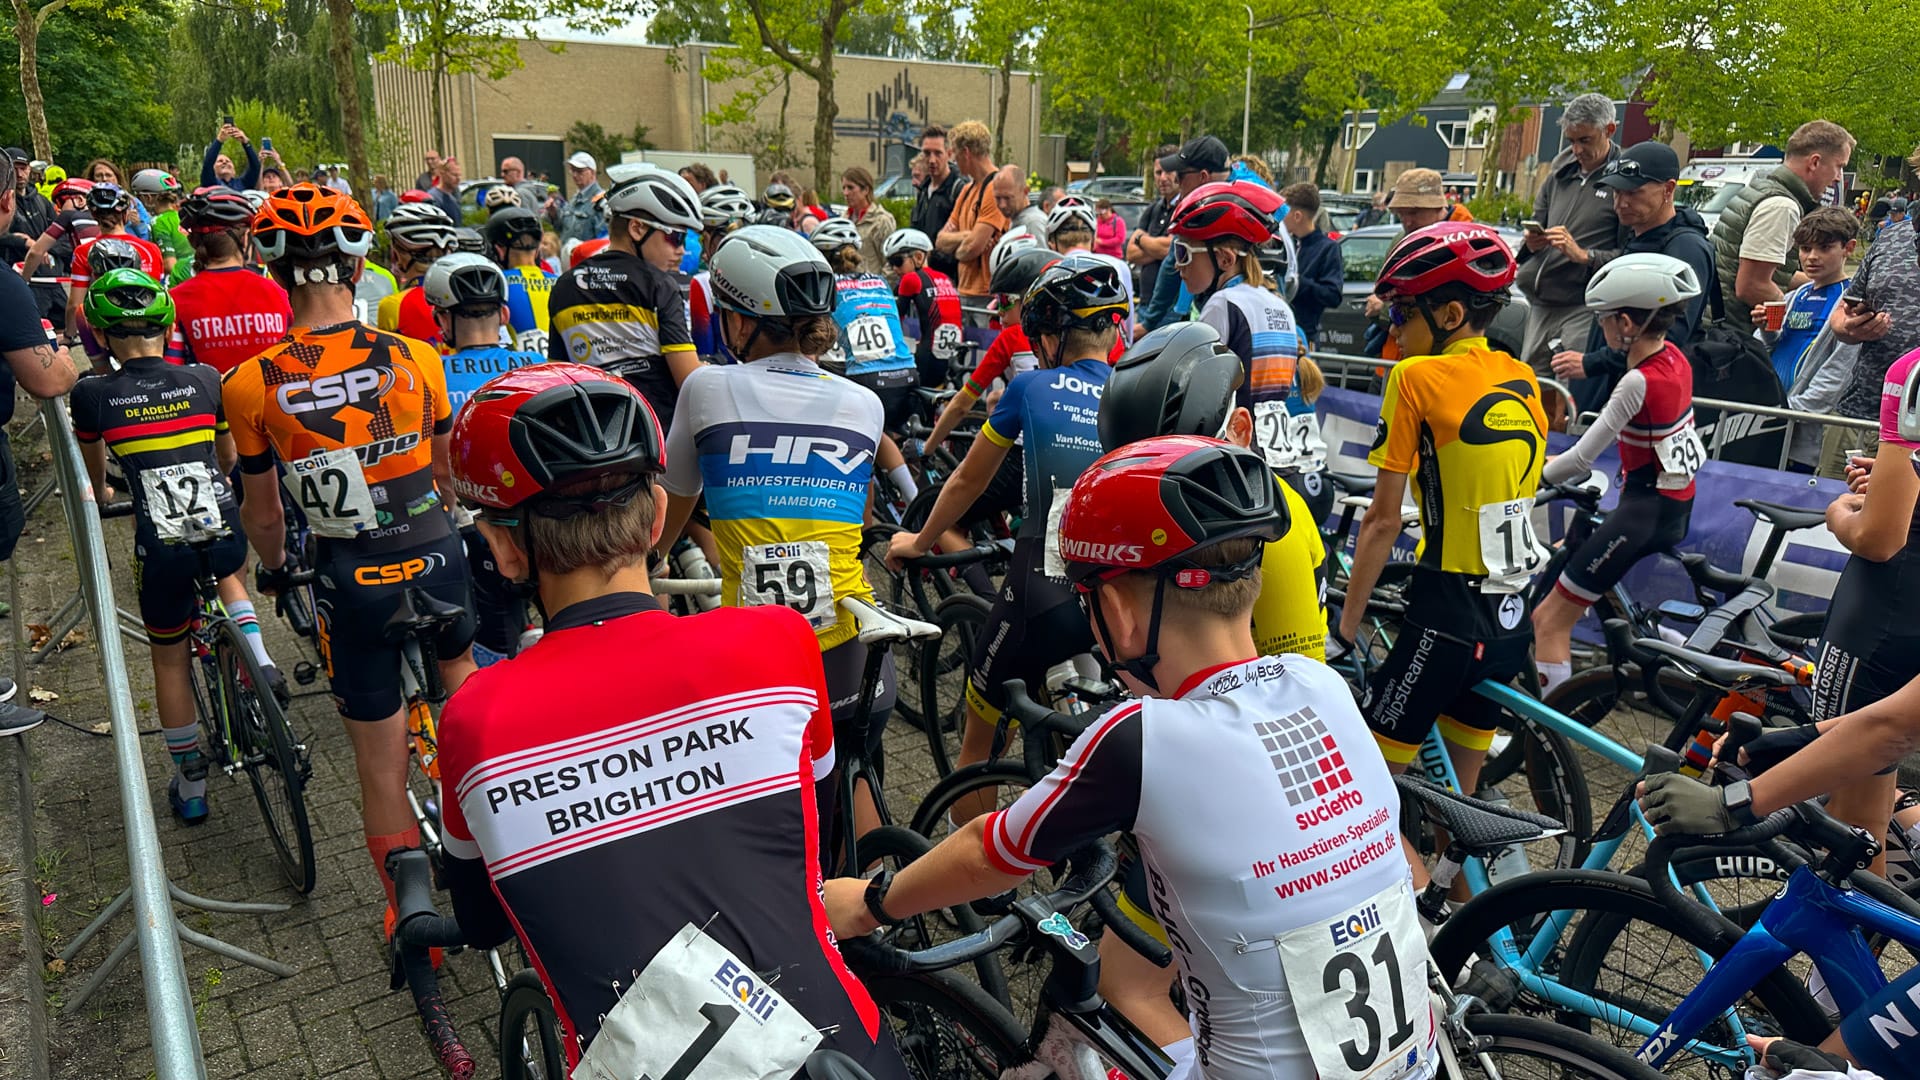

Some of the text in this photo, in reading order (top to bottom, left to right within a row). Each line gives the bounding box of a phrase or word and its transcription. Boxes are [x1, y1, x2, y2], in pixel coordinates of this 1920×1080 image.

[1443, 230, 1489, 244] KASK
[192, 312, 284, 340] STRATFORD
[857, 324, 886, 350] 46
[205, 337, 278, 349] CYCLING CLUB
[109, 395, 149, 407] Wood55
[161, 385, 197, 400] nysingh
[276, 368, 381, 415] CSP
[1052, 401, 1061, 411] T.
[1063, 404, 1080, 413] van
[125, 400, 190, 418] DE ADELAAR
[1056, 433, 1073, 444] Van
[295, 455, 329, 473] EQili
[1671, 438, 1700, 475] 39
[155, 476, 208, 520] 12
[300, 468, 360, 519] 42
[727, 475, 865, 494] HARVESTEHUDER R.V.
[768, 496, 837, 509] HAMBURG
[369, 524, 410, 539] bikmo
[765, 545, 800, 558] EQili
[354, 558, 426, 586] CSP
[755, 560, 817, 615] 59
[1381, 628, 1437, 730] Slipstreamers
[1819, 646, 1841, 696] LOSSER
[487, 717, 754, 814] PRESTON PARK
[546, 762, 725, 835] BRIGHTON
[1296, 790, 1363, 830] sucietto
[1252, 806, 1390, 879] Ihr Haustüren-Spezialist
[1274, 830, 1396, 900] www.sucietto.de
[1329, 903, 1381, 946] EQili
[715, 959, 779, 1020] EQili
[1323, 932, 1414, 1071] 31
